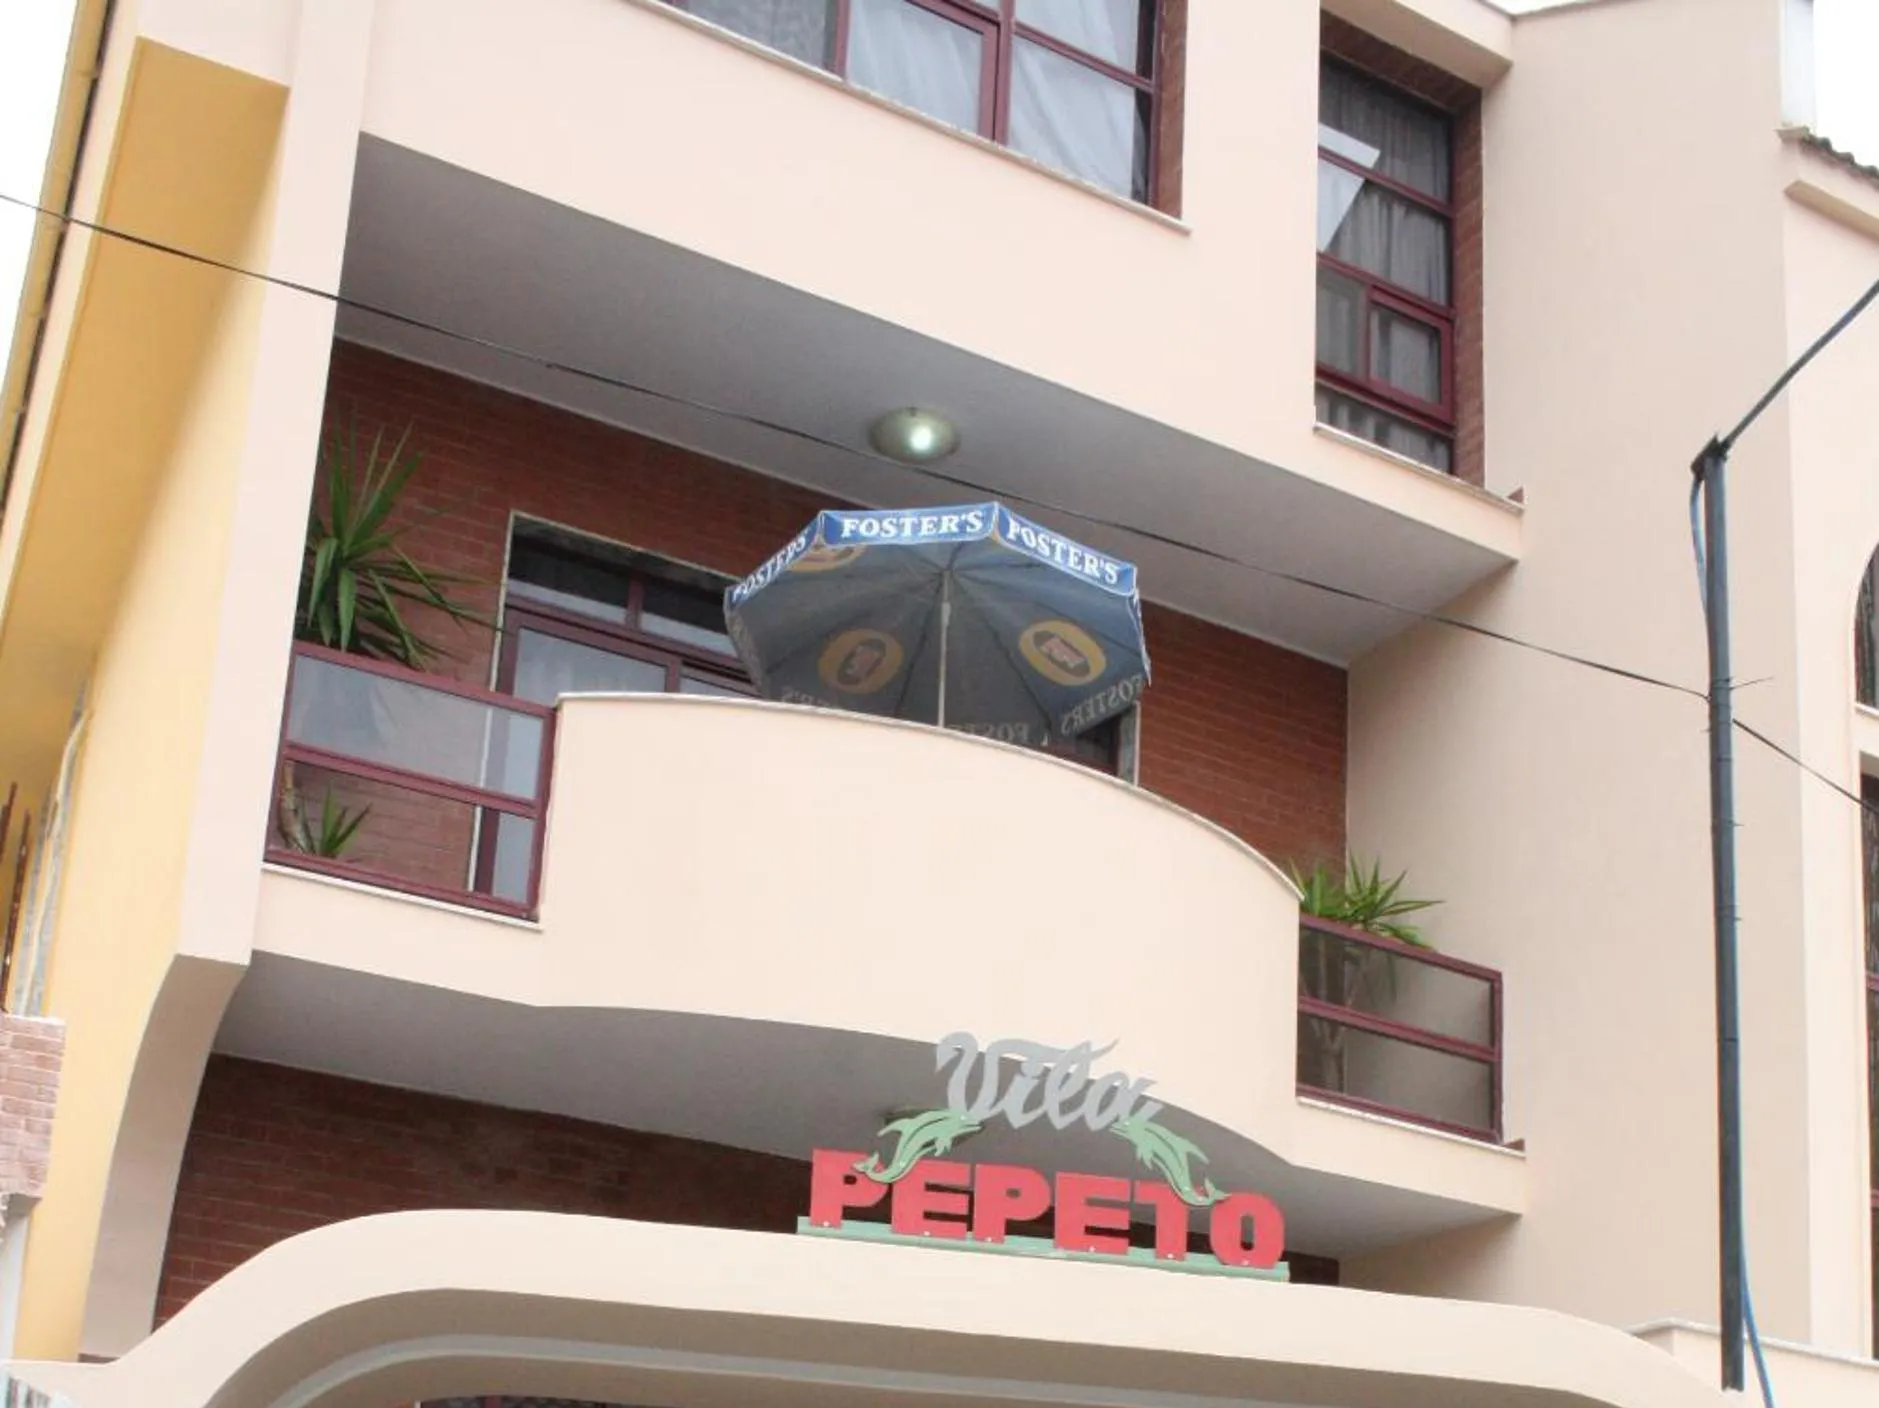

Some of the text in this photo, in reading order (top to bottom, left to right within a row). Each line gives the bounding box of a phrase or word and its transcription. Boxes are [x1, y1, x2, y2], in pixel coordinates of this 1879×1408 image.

[841, 510, 983, 538] FOSTER'S
[1007, 516, 1118, 585] FOSTER'S
[808, 1148, 1285, 1269] PEPETO
